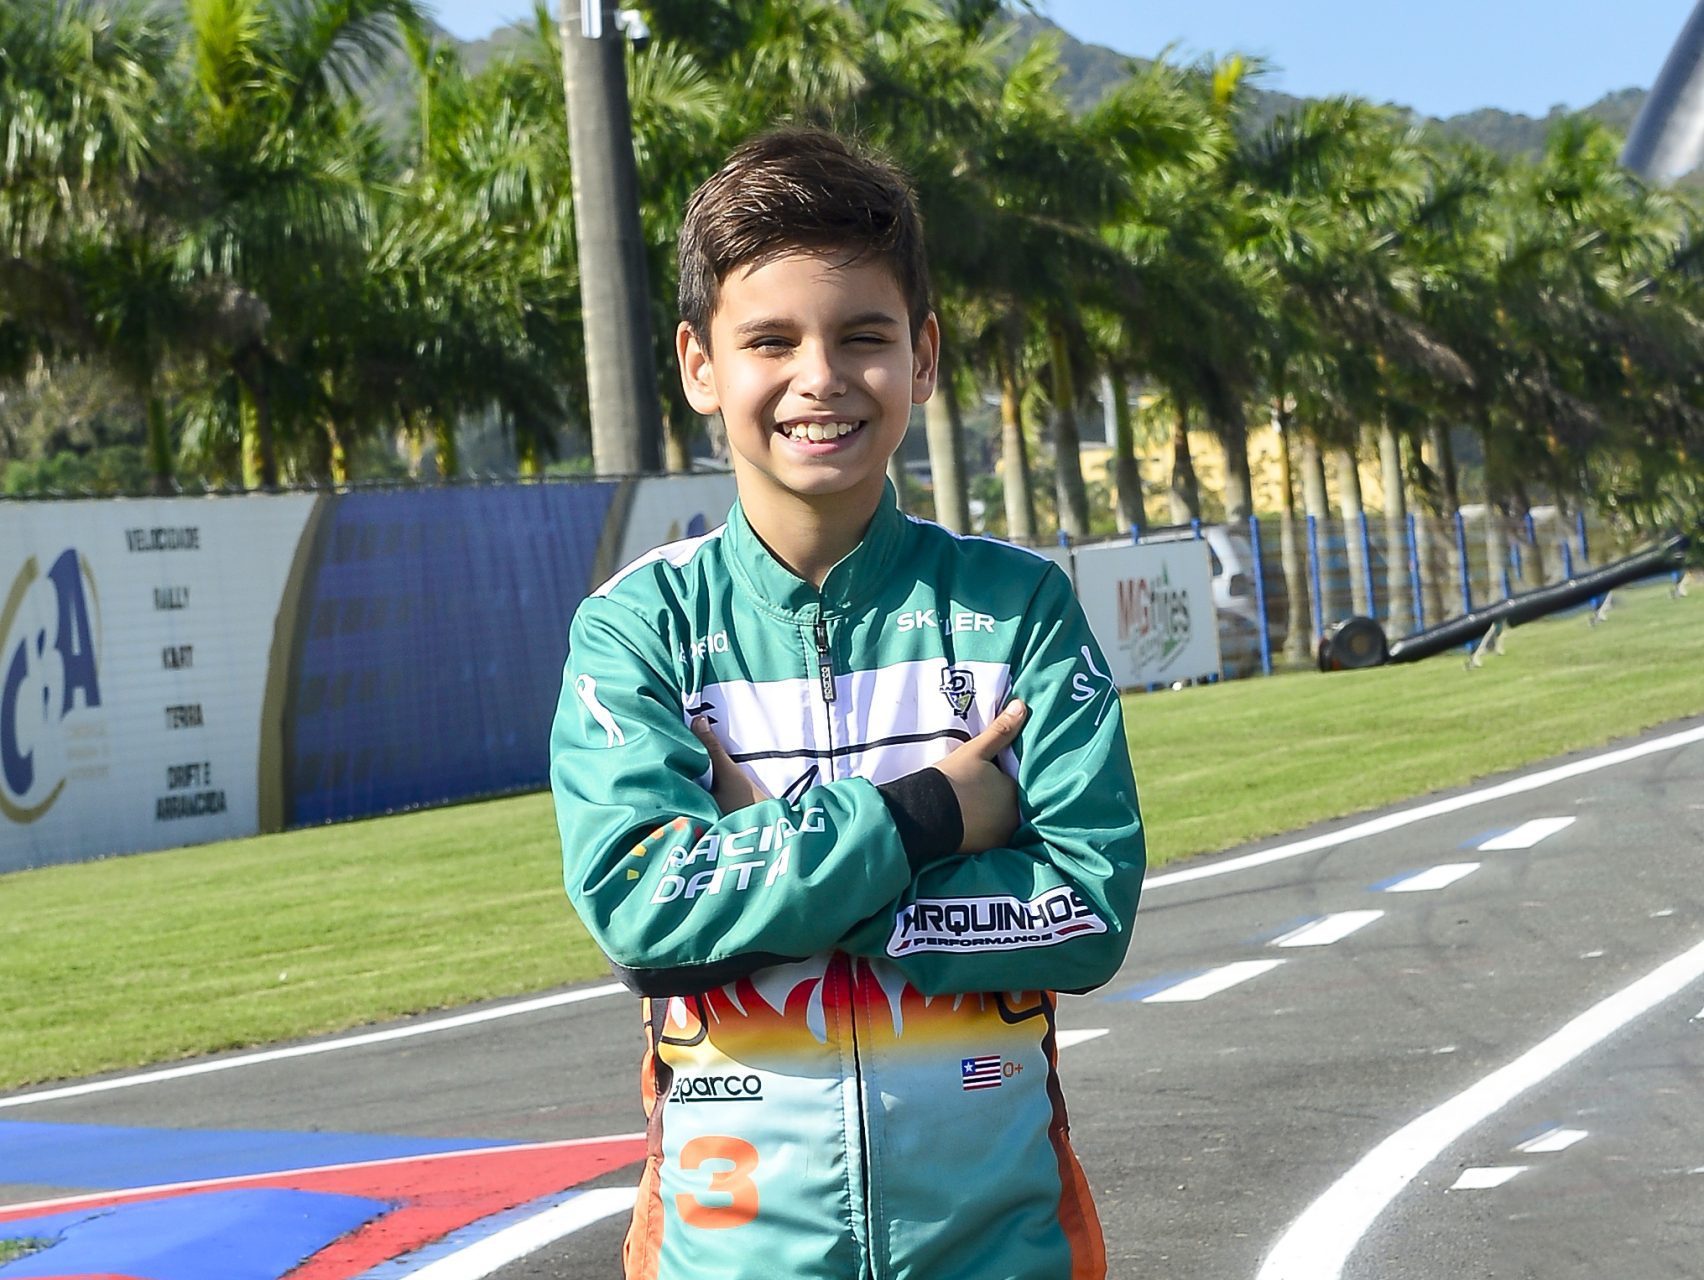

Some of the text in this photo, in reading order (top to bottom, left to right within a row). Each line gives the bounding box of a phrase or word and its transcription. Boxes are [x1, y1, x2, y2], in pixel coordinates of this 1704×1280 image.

[650, 845, 790, 904] DATA
[913, 932, 1053, 947] PERFORMANCE
[675, 1135, 760, 1230] 3
